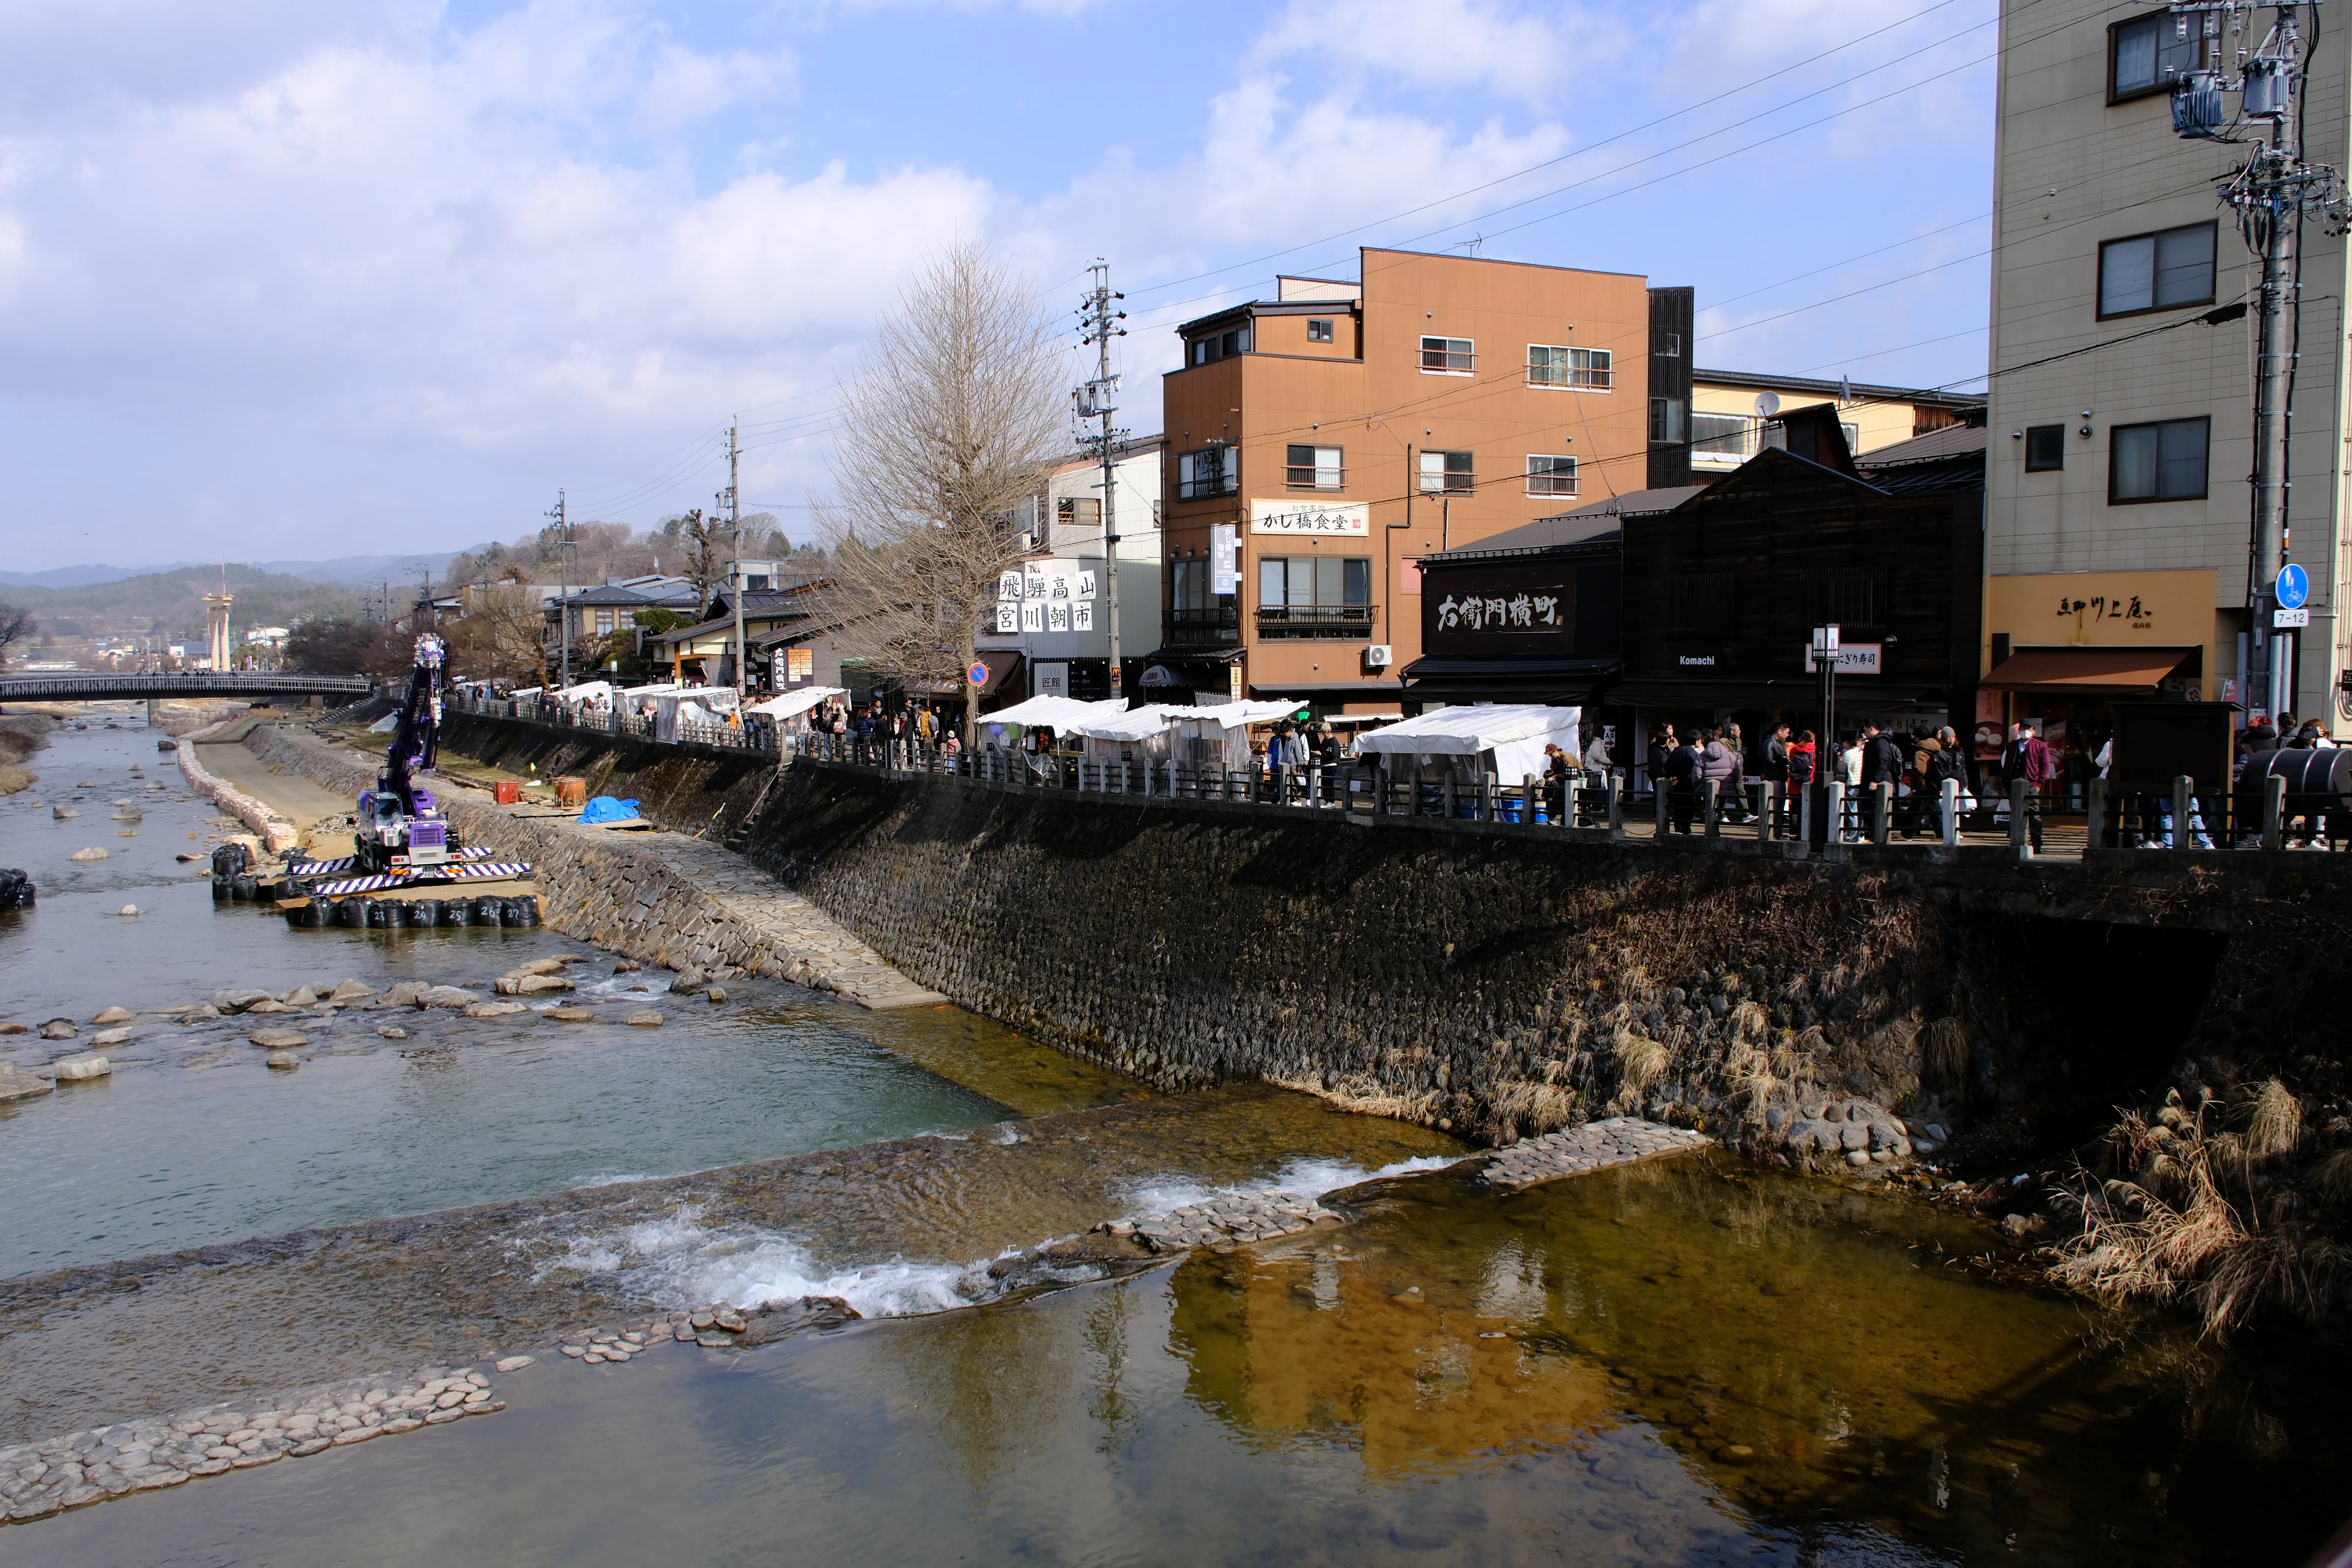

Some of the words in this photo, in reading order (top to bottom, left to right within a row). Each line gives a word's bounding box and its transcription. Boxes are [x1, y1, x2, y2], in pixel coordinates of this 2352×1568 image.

[1263, 513, 1348, 530] かじ橋食堂
[1217, 543, 1224, 559] 珈琲
[1001, 576, 1094, 598] 飛騨高山
[998, 605, 1090, 628] 宮川朝市
[1438, 593, 1558, 631] 右衛門横町
[2278, 613, 2304, 623] 7-12
[1680, 656, 1715, 665] Komachi
[1043, 677, 1061, 688] 匠館
[374, 911, 385, 921] 23
[413, 910, 427, 920] 24
[449, 910, 462, 922] 25
[481, 906, 495, 918] 26
[507, 909, 519, 920] 27
